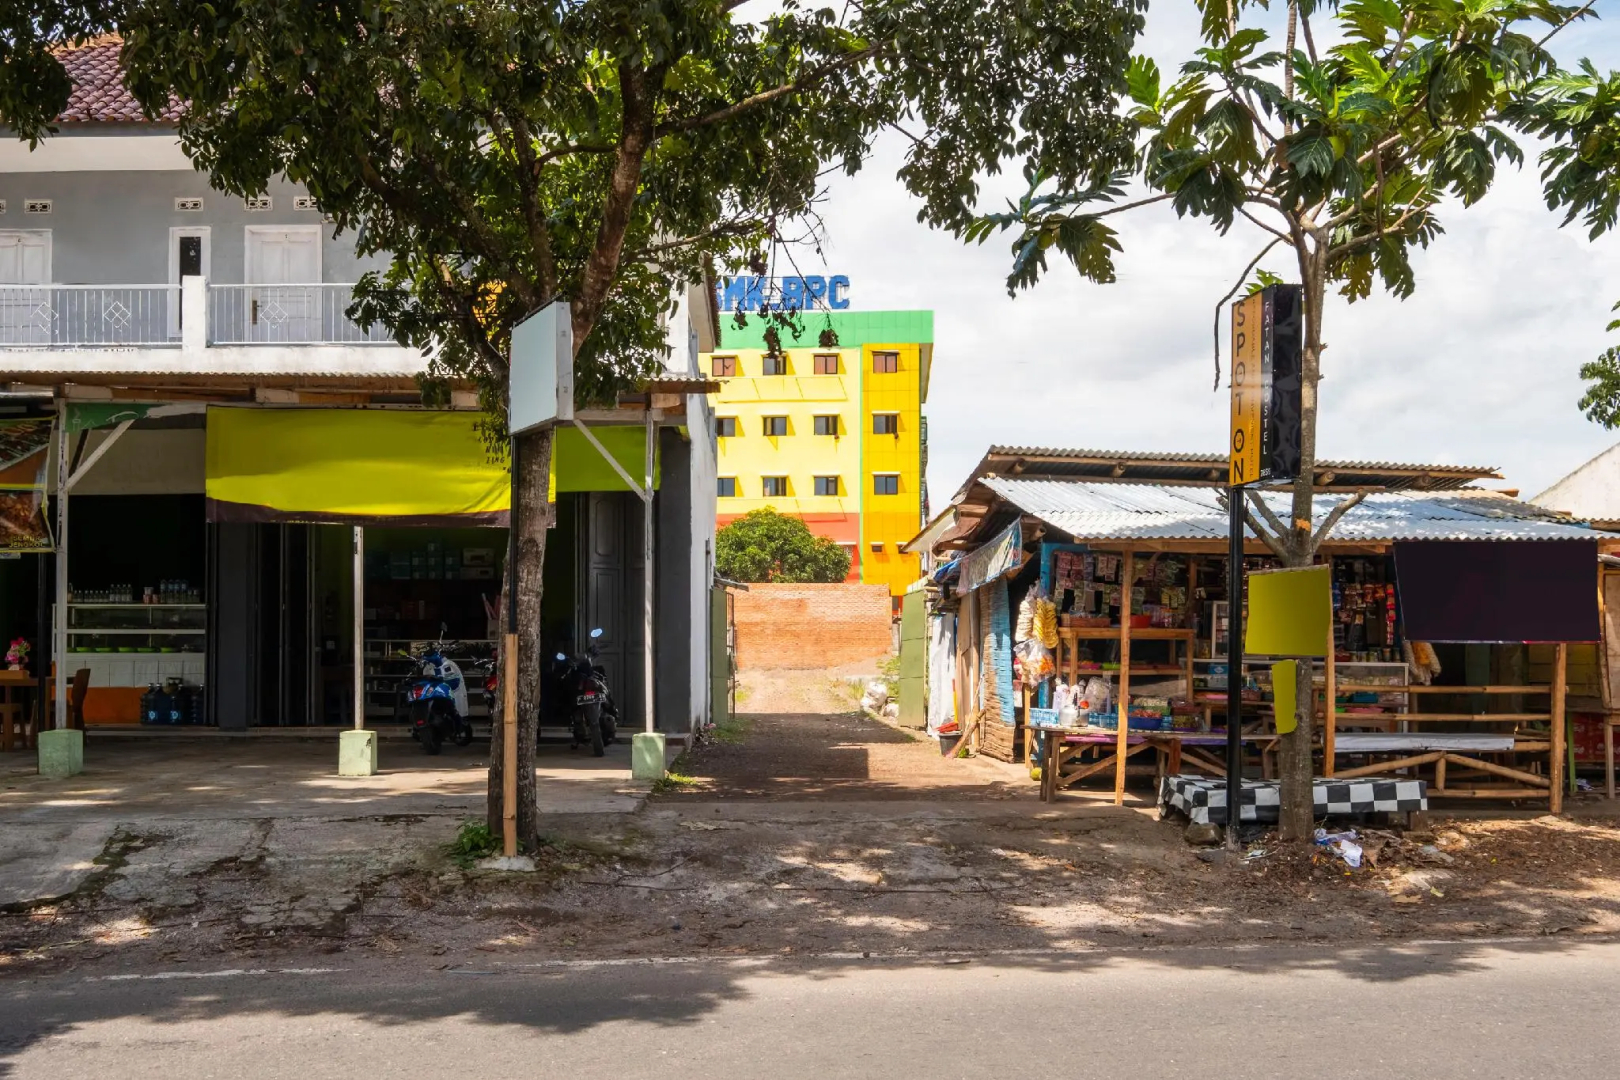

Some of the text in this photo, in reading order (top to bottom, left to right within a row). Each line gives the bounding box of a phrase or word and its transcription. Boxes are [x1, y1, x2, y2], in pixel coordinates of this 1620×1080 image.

[782, 275, 850, 310] BPC
[1233, 301, 1246, 483] SPOT ON
